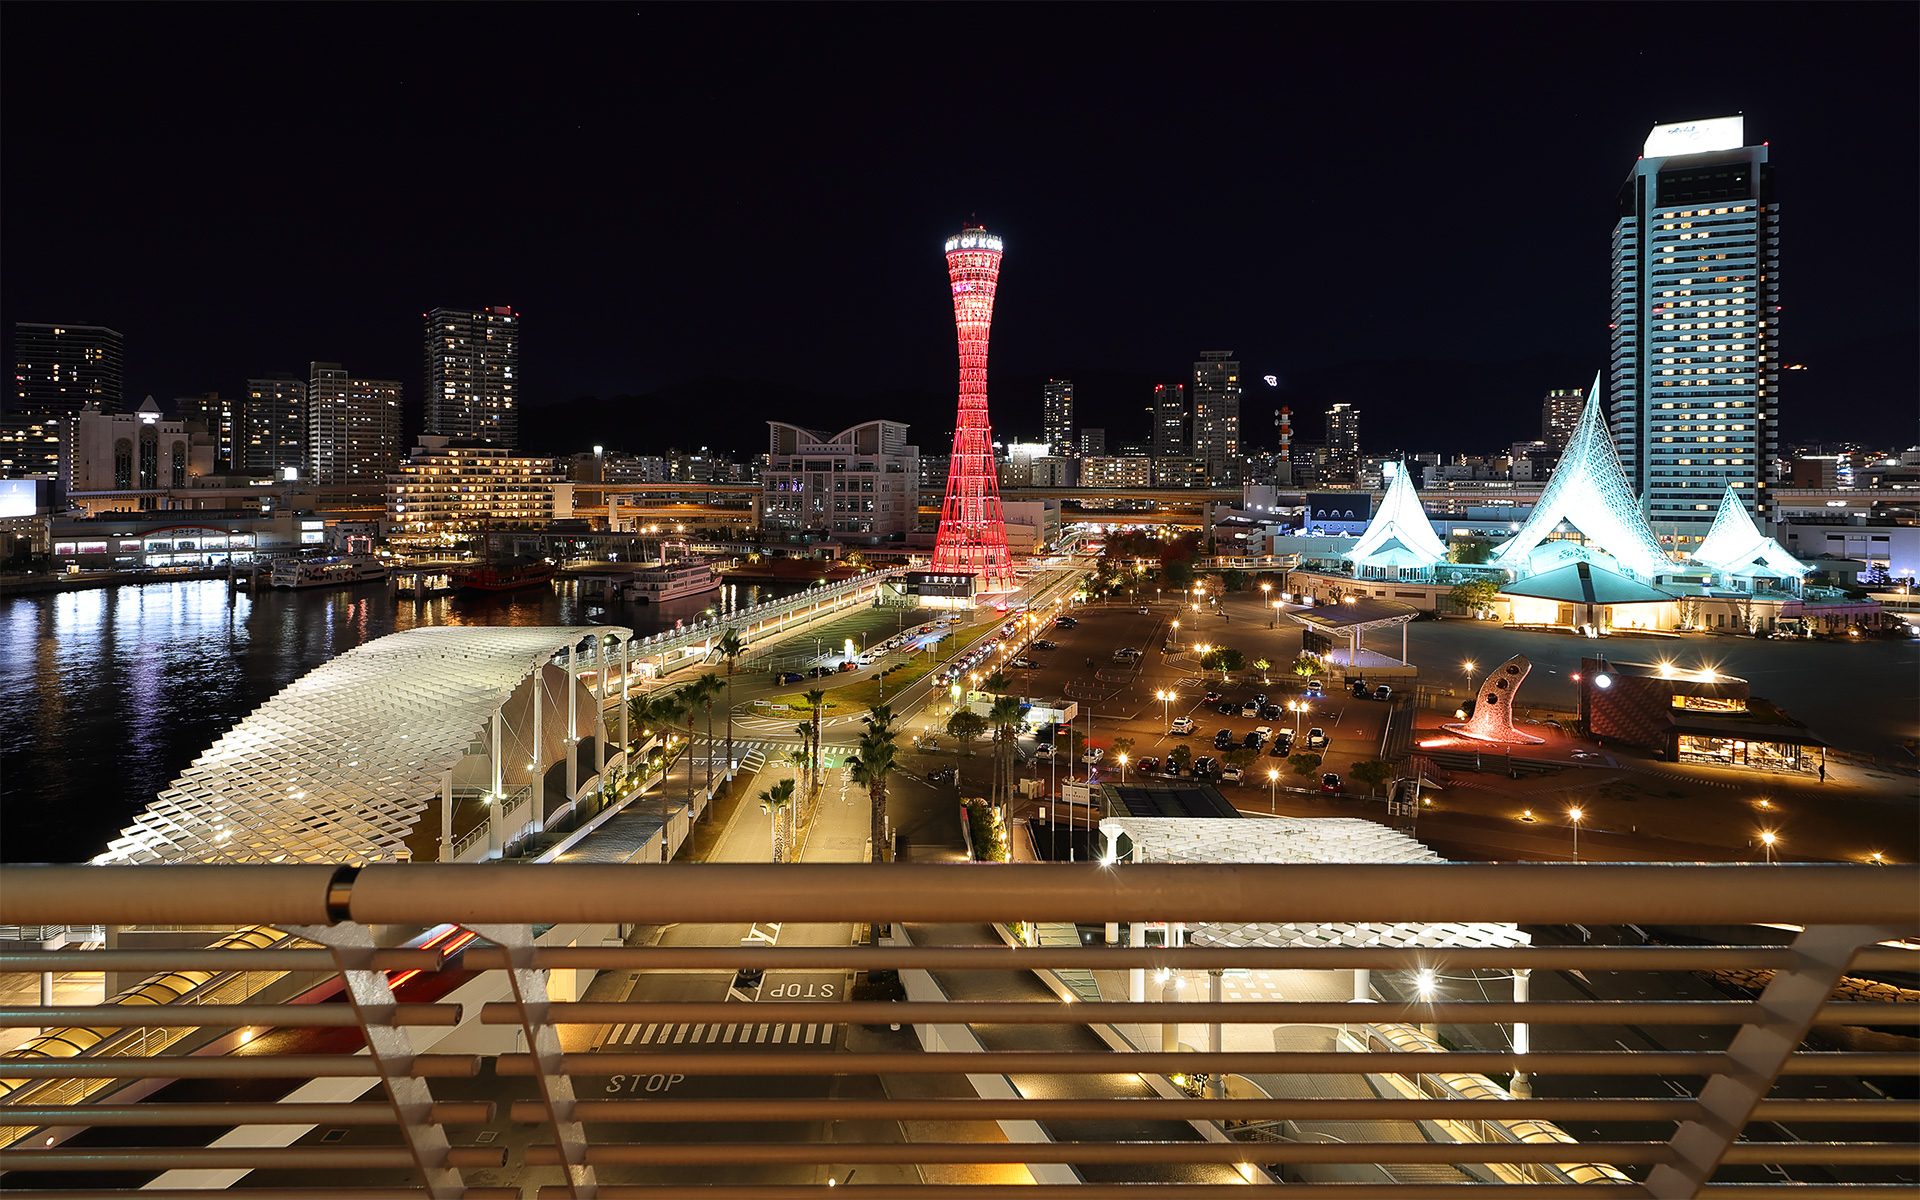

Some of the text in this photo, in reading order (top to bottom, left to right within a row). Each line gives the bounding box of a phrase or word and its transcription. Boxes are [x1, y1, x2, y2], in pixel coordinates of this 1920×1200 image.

[961, 237, 977, 248] OF
[770, 983, 835, 998] STOP
[606, 1073, 685, 1093] STOP
